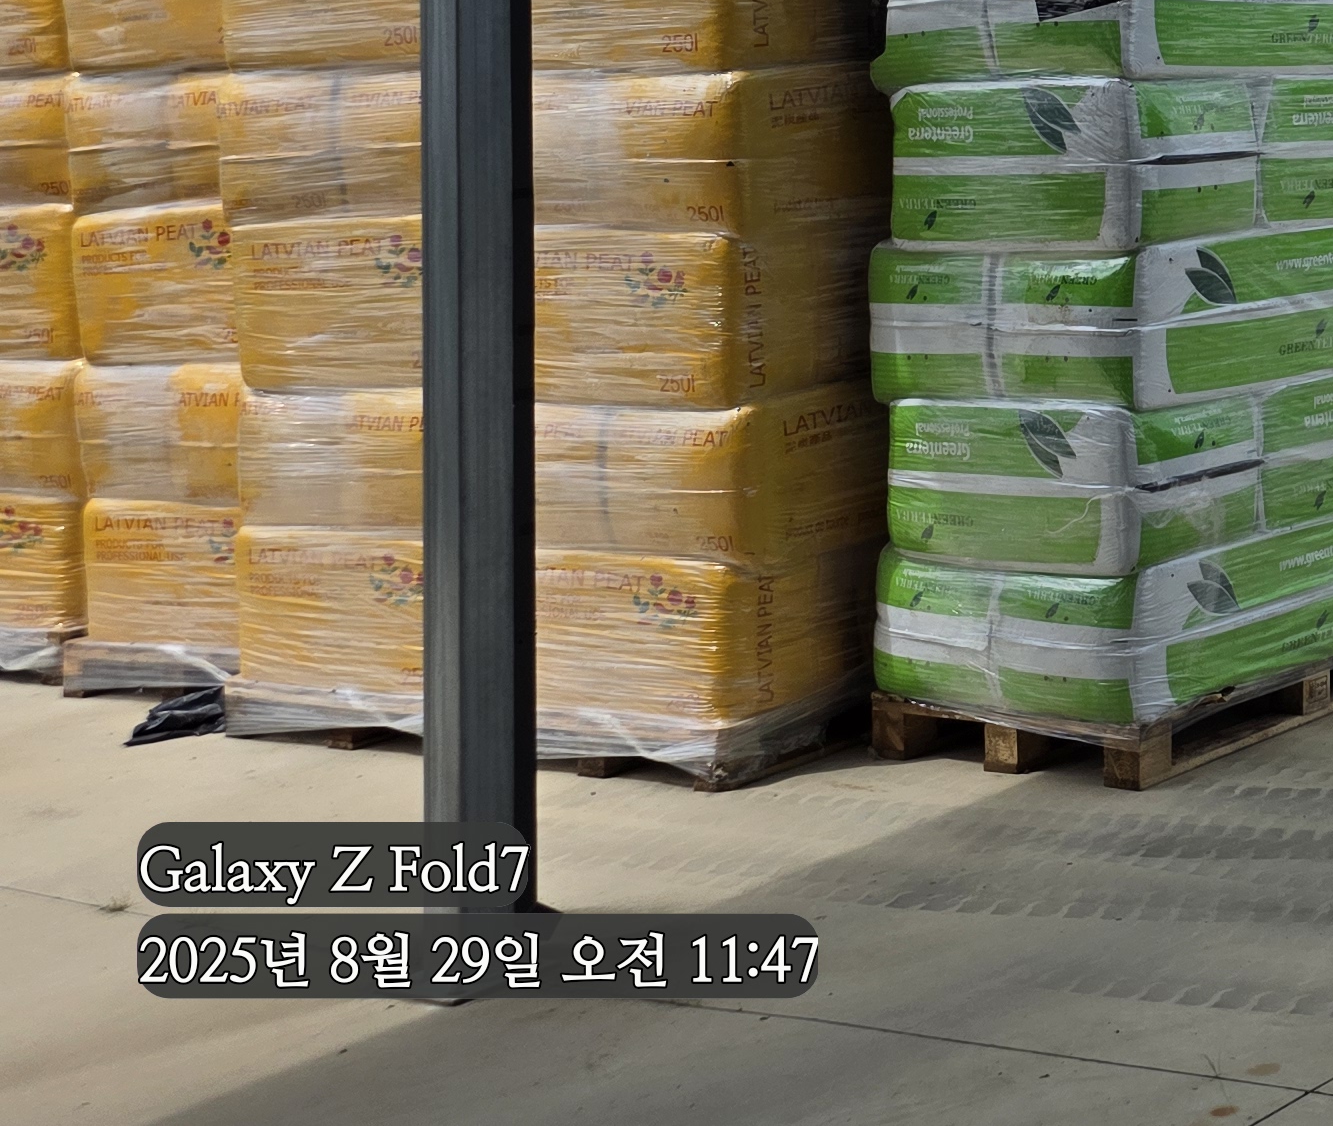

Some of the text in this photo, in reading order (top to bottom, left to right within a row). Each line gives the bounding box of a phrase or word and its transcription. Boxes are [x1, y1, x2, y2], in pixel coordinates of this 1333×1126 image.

[686, 205, 723, 222] 250l
[155, 224, 197, 242] PEAT
[178, 392, 229, 407] ATVIAN
[906, 441, 971, 461] Greenterra
[757, 572, 775, 704] LATVIAN PEAT
